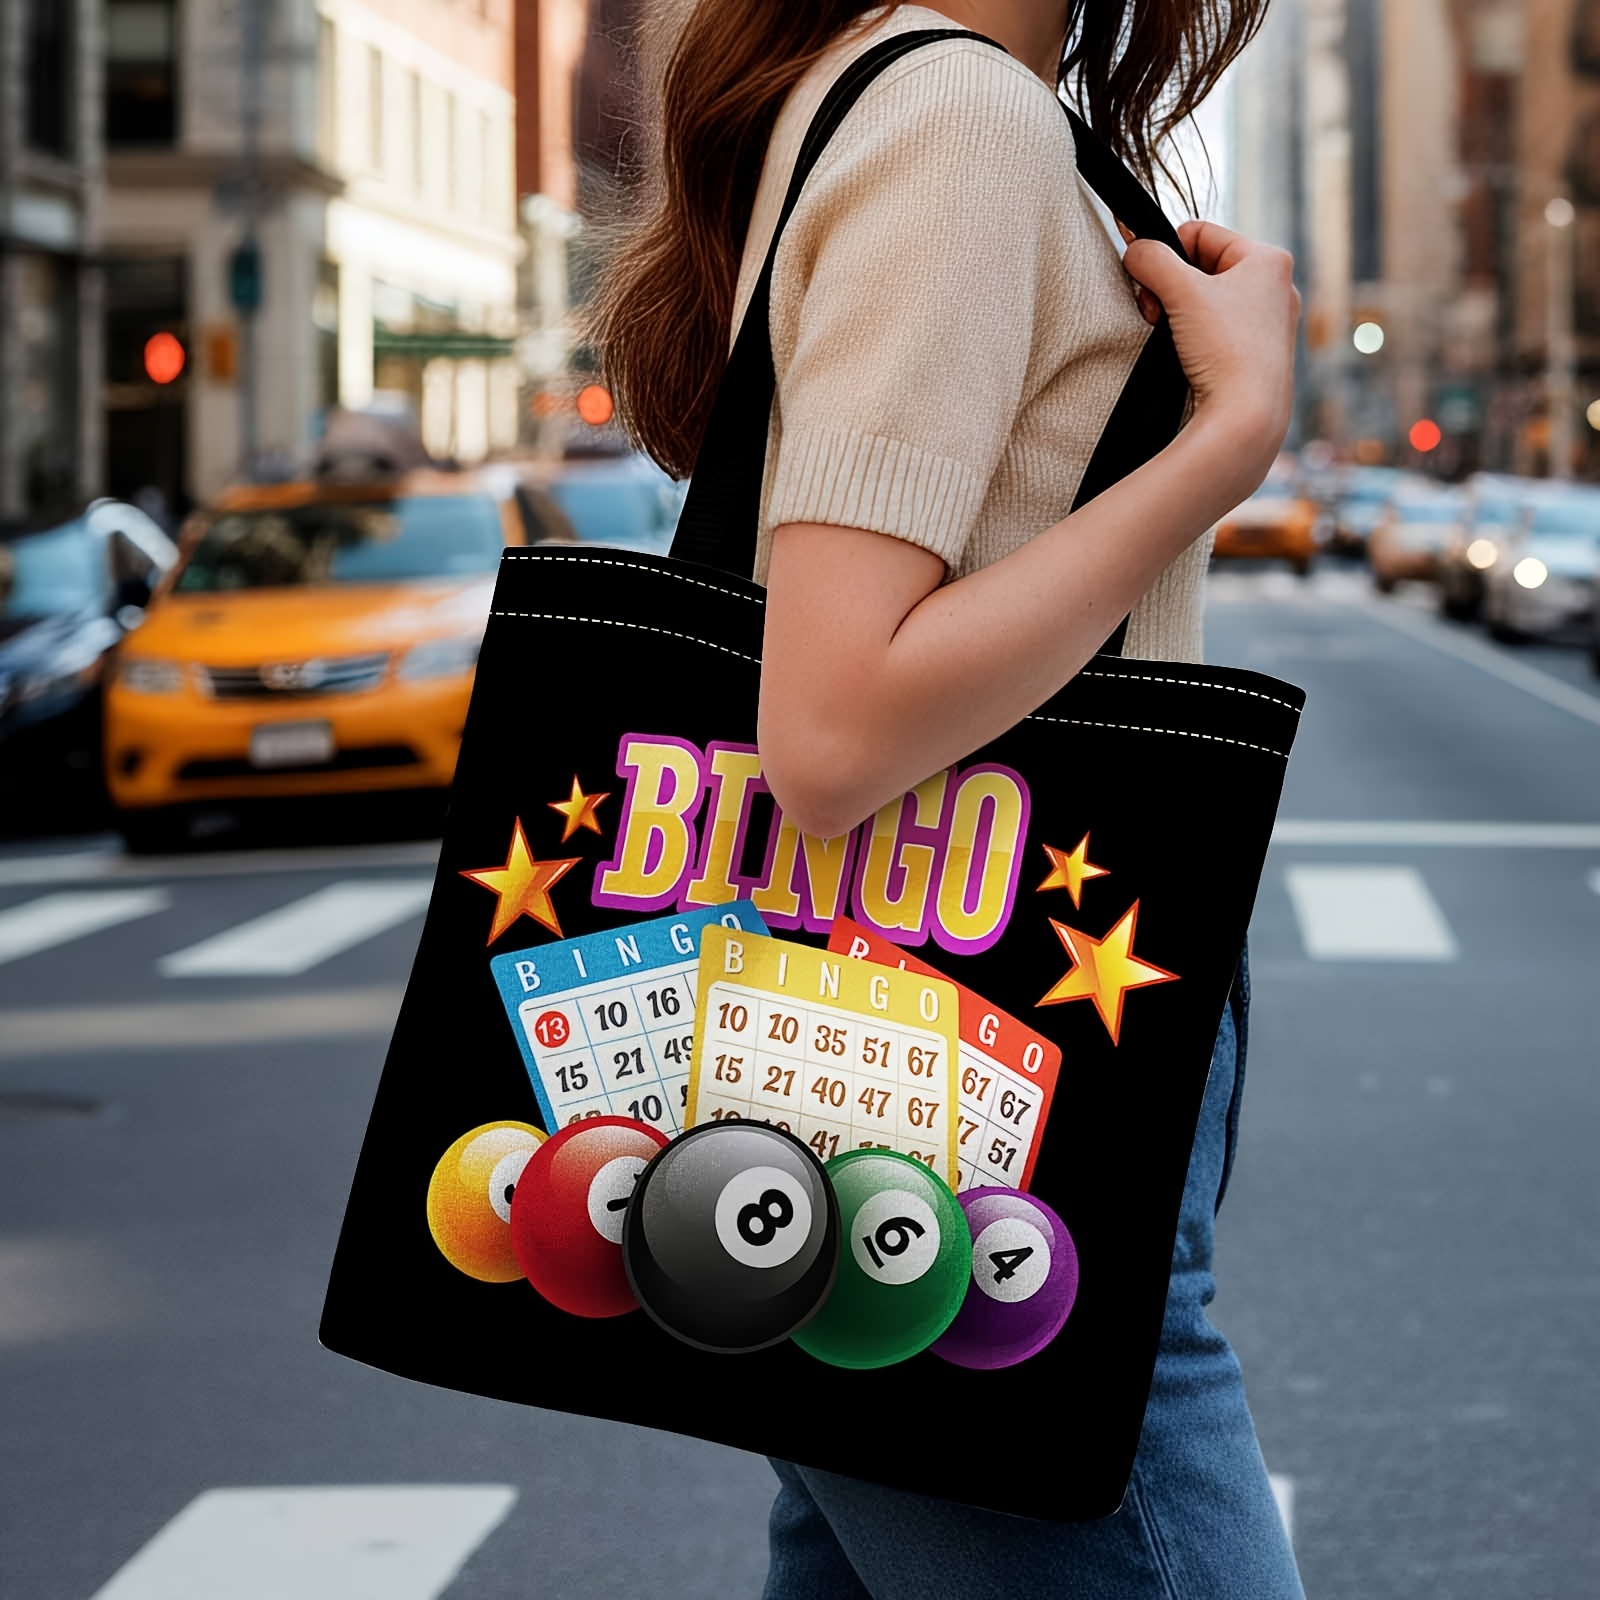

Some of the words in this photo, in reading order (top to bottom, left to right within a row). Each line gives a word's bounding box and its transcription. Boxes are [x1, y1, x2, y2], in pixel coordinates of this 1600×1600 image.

[596, 738, 1026, 946] BINGO
[724, 938, 939, 1022] BINGO
[538, 1016, 566, 1043] 13
[594, 1001, 628, 1031] 10
[646, 987, 680, 1019] 16
[718, 1002, 748, 1033] 10
[814, 1024, 847, 1056] 35
[862, 1037, 891, 1068] 51
[907, 1046, 939, 1078] 67
[555, 1061, 588, 1092] 15
[613, 1047, 645, 1080] 21
[714, 1054, 744, 1083] 15
[762, 1065, 796, 1096] 21
[811, 1076, 847, 1108] 40
[858, 1087, 892, 1118] 47
[907, 1096, 941, 1129] 67
[962, 1067, 991, 1101] 61
[1000, 1090, 1031, 1125] 67
[628, 1094, 662, 1122] 10
[809, 1130, 841, 1159] 41
[988, 1138, 1017, 1173] 51
[737, 1189, 794, 1247] 8
[988, 1246, 1034, 1285] 4
